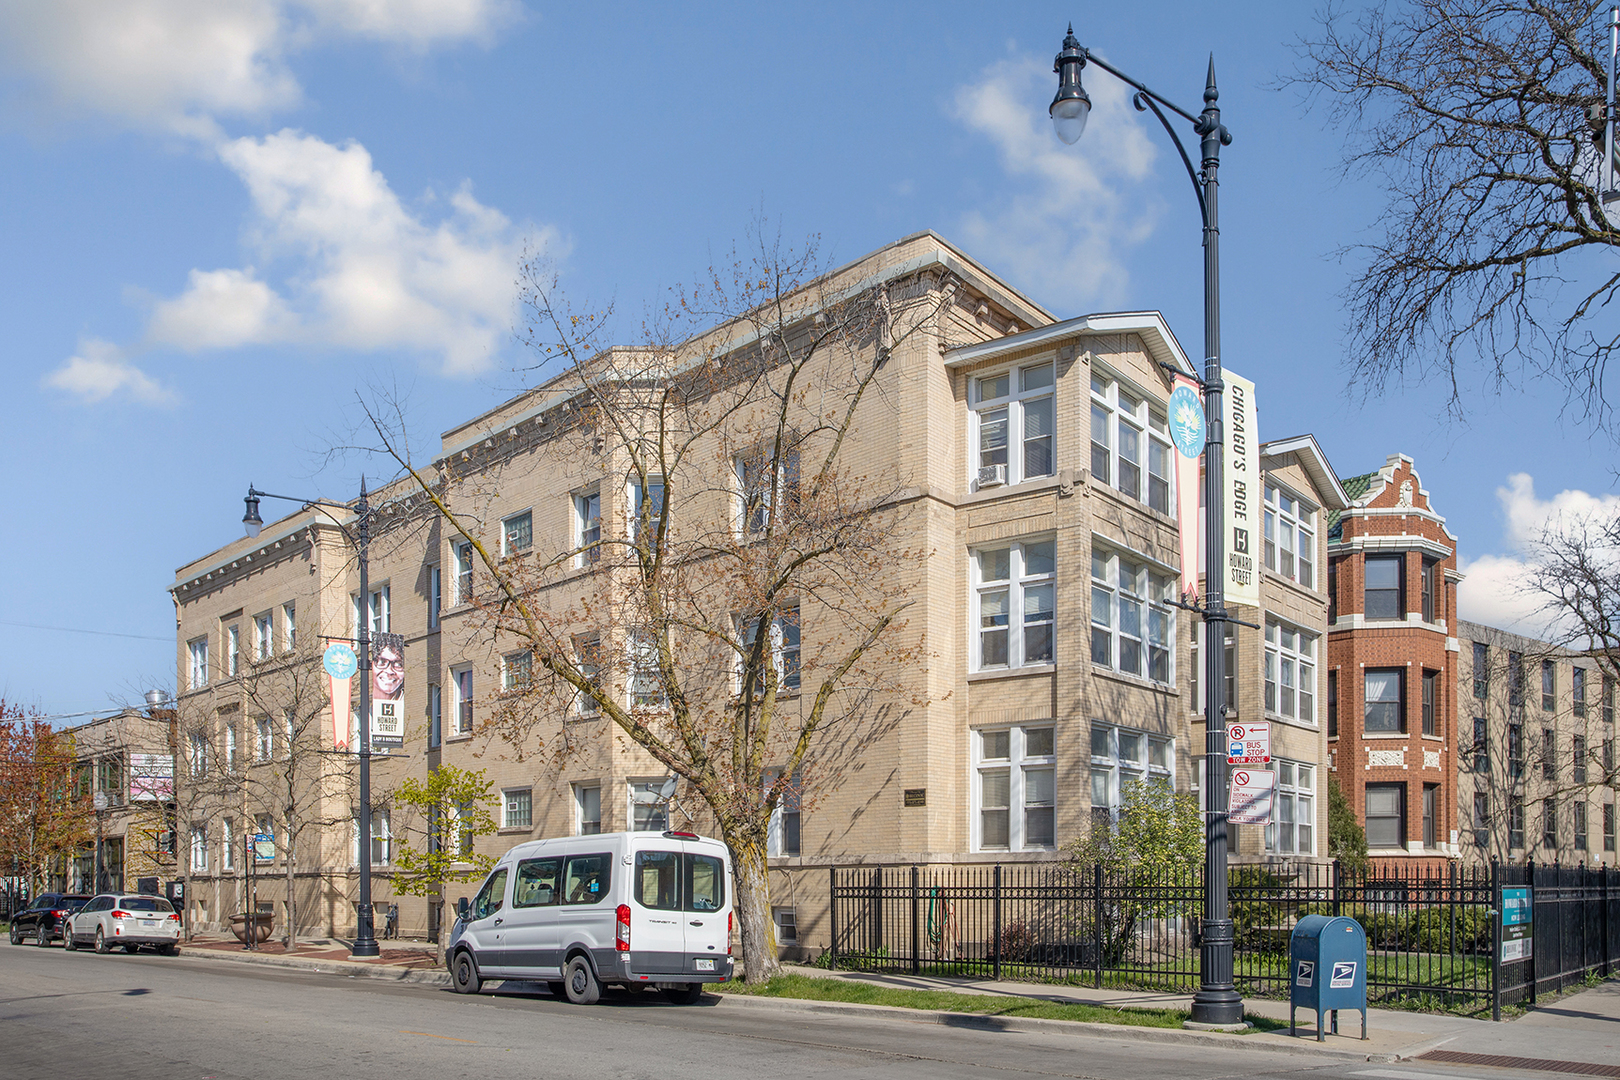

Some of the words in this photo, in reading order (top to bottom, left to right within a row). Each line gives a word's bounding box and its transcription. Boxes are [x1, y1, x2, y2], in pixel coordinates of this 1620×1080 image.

[1174, 386, 1200, 409] HOWARD
[1232, 384, 1247, 472] CHICAGO'S
[1177, 439, 1200, 457] STREET
[1234, 481, 1247, 521] EDGE
[1229, 552, 1253, 572] HOWARD
[1231, 568, 1252, 586] STREET
[377, 716, 398, 724] HOWARD
[379, 724, 397, 732] STREET
[1246, 741, 1261, 749] BUS
